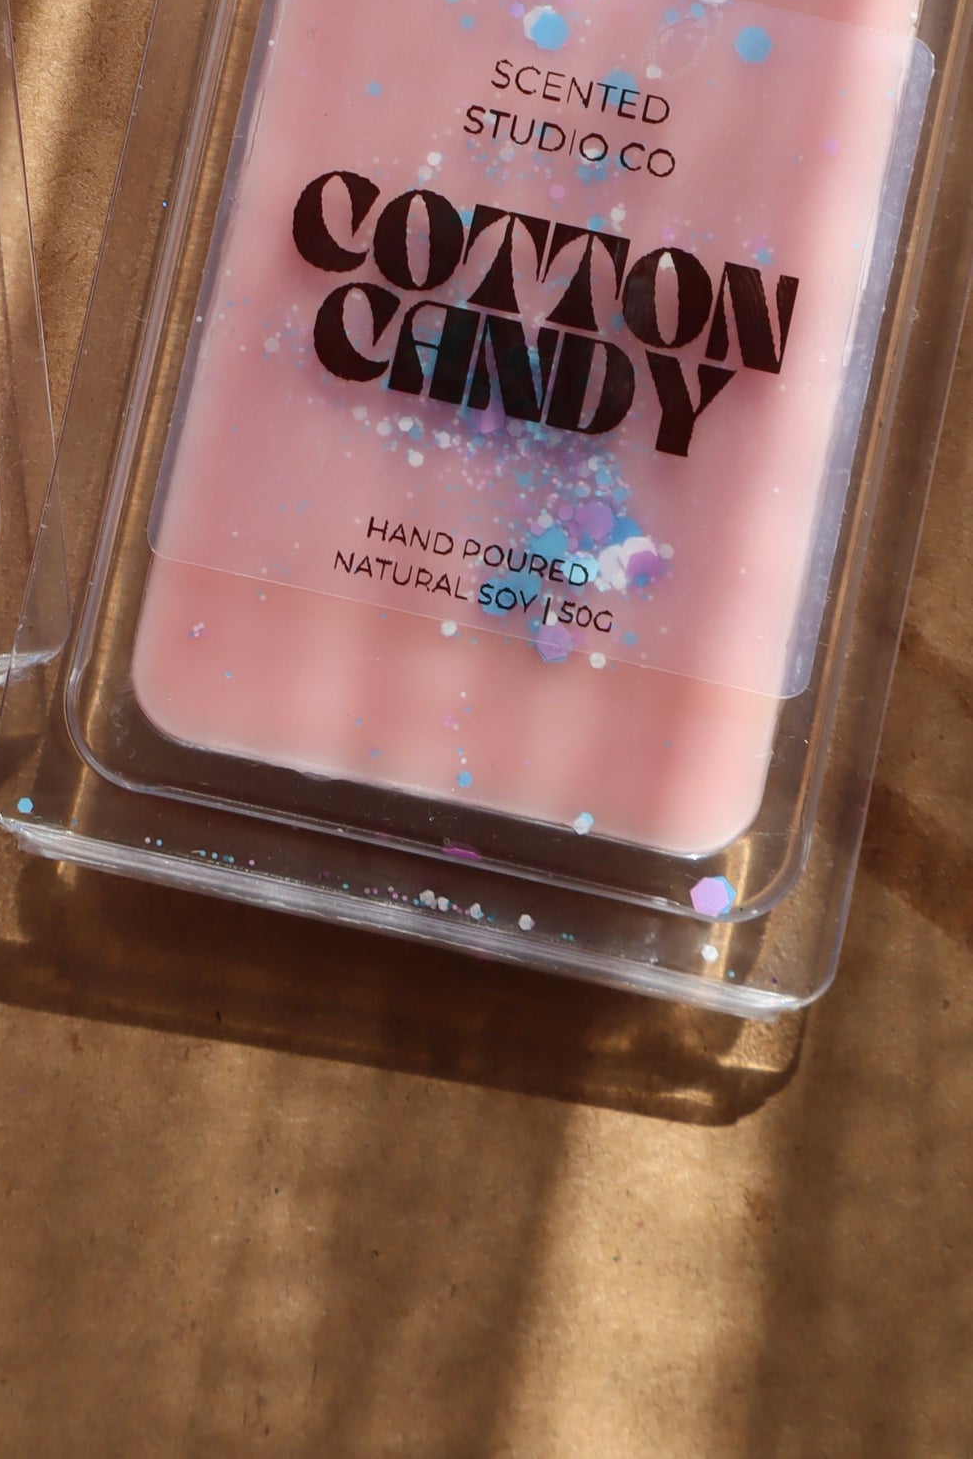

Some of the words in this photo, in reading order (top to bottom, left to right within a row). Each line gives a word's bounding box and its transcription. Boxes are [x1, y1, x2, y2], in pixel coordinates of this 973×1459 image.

[490, 59, 670, 125] SCENTED
[463, 105, 609, 162] STUDIO
[619, 142, 676, 178] CO
[292, 170, 800, 375] COTTON
[313, 281, 738, 457] CANDY
[366, 516, 454, 556] HAND
[462, 539, 589, 587] POURED
[334, 550, 469, 601] NATURAL
[477, 582, 538, 614] SOY
[557, 600, 614, 633] 50G
